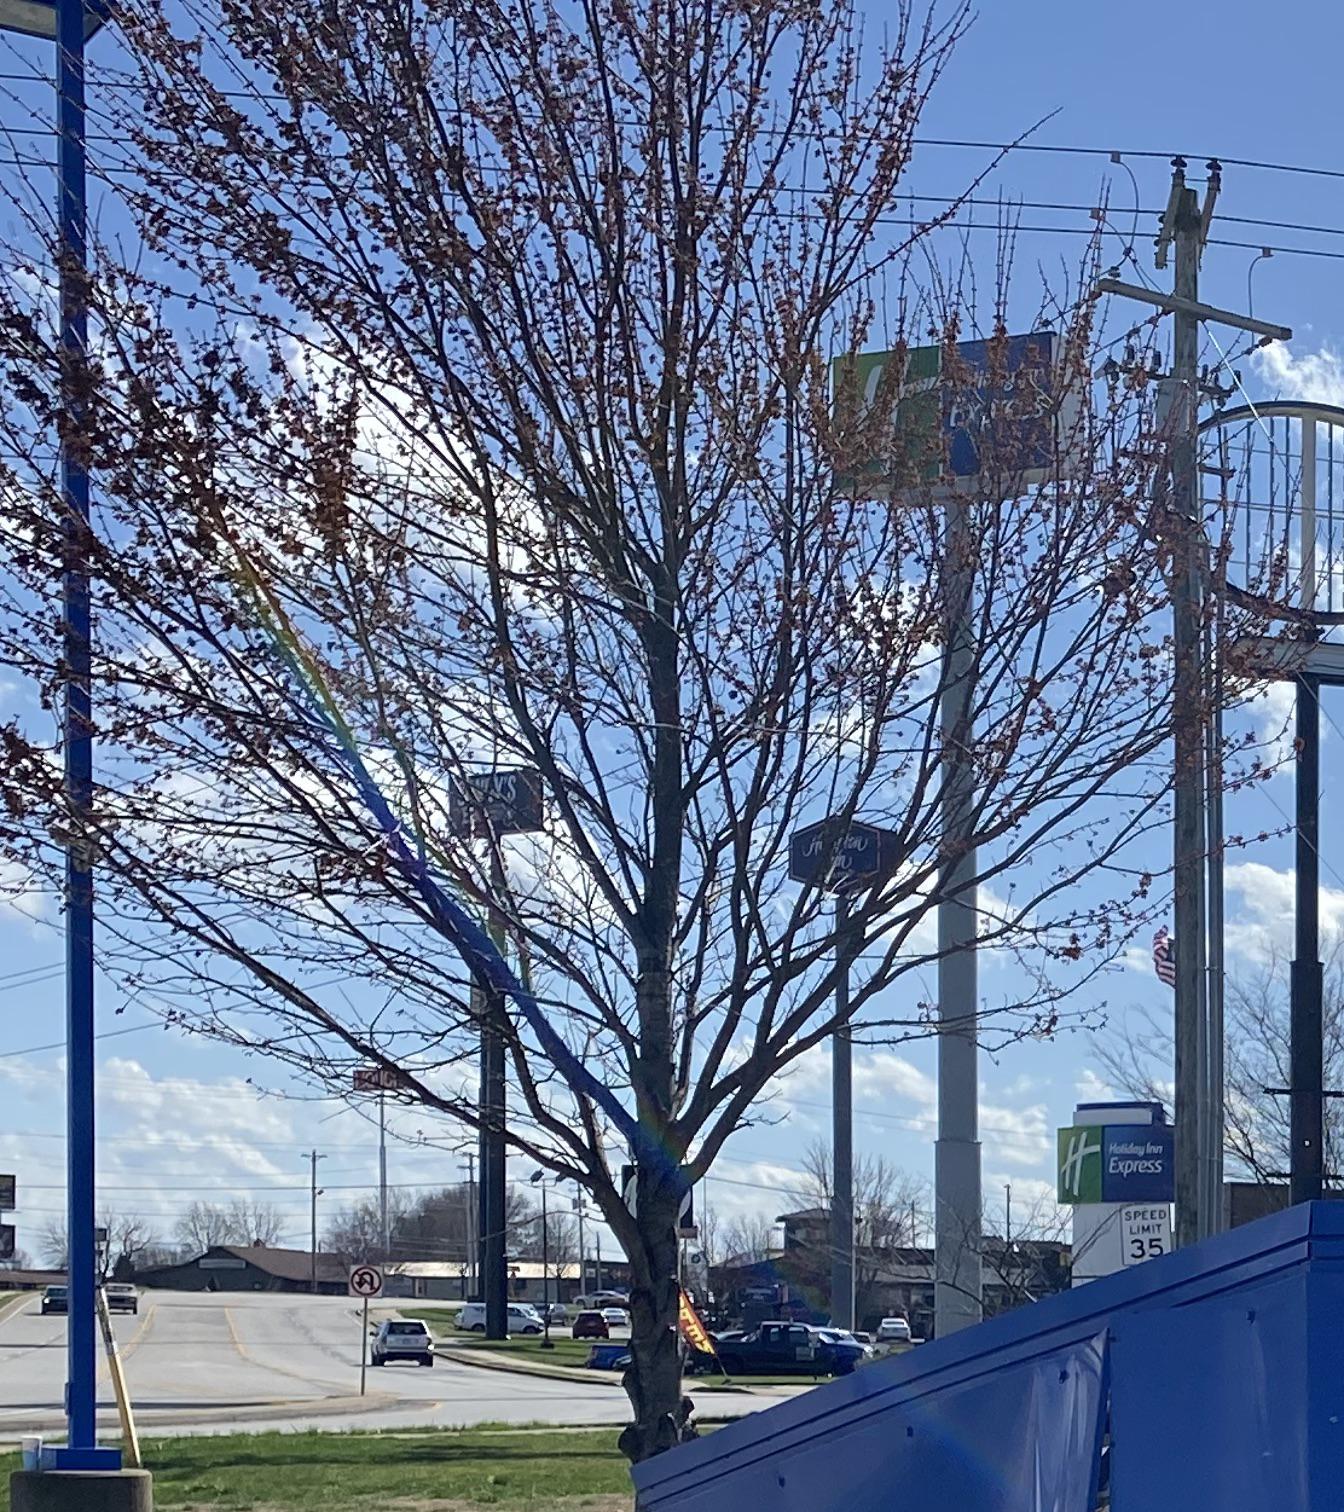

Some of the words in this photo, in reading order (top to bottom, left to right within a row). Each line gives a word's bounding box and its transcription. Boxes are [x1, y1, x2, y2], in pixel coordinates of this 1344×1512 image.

[1109, 1143, 1145, 1157] Holiday
[1146, 1143, 1164, 1154] Inn
[1109, 1157, 1162, 1177] Express
[1124, 1210, 1167, 1221] SPEED
[1129, 1224, 1162, 1235] LIMIT
[1130, 1238, 1164, 1259] 35
